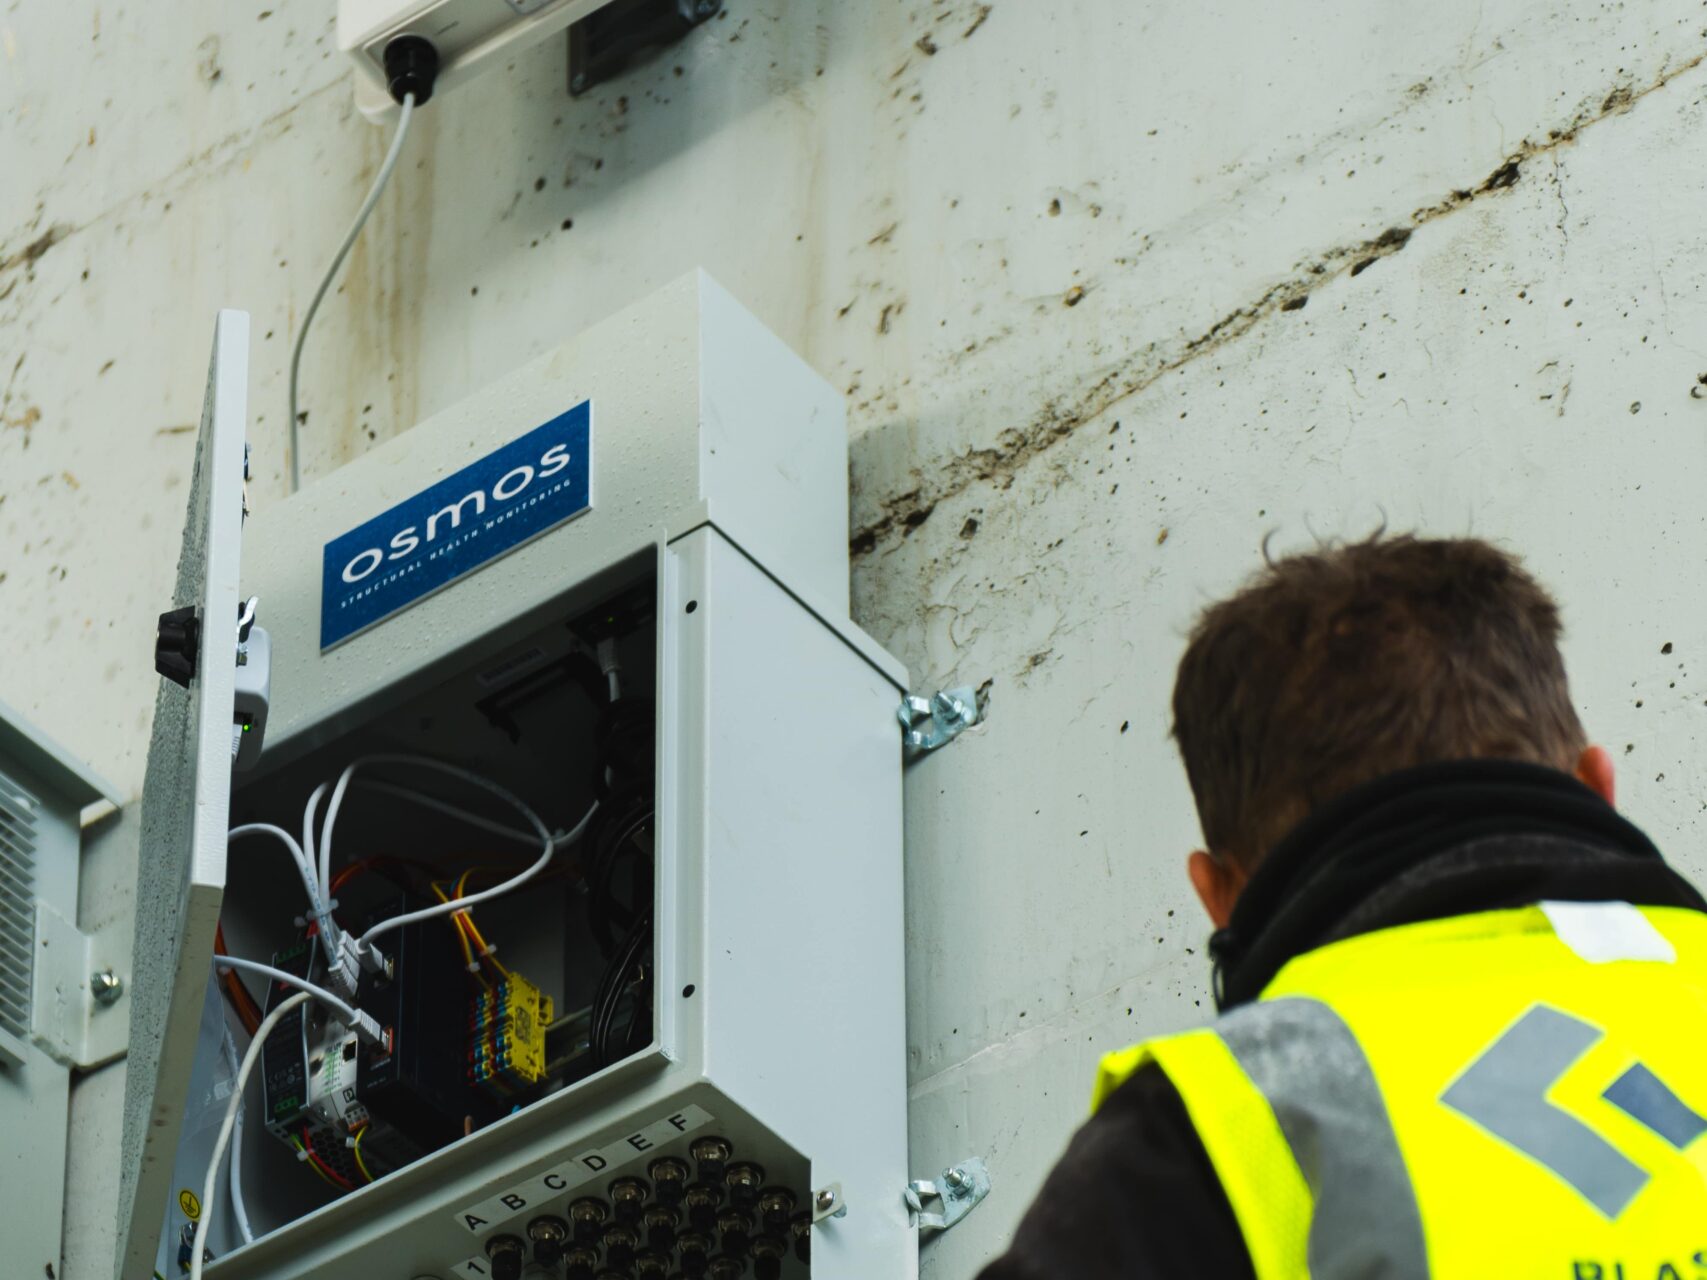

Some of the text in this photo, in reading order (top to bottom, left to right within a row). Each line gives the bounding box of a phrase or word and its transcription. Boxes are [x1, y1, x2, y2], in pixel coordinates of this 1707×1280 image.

[340, 478, 571, 609] STRUCTURAL HEALTH MONITORING
[341, 443, 571, 583] osmos
[464, 1113, 690, 1231] A B C D E F
[467, 1260, 486, 1275] 1
